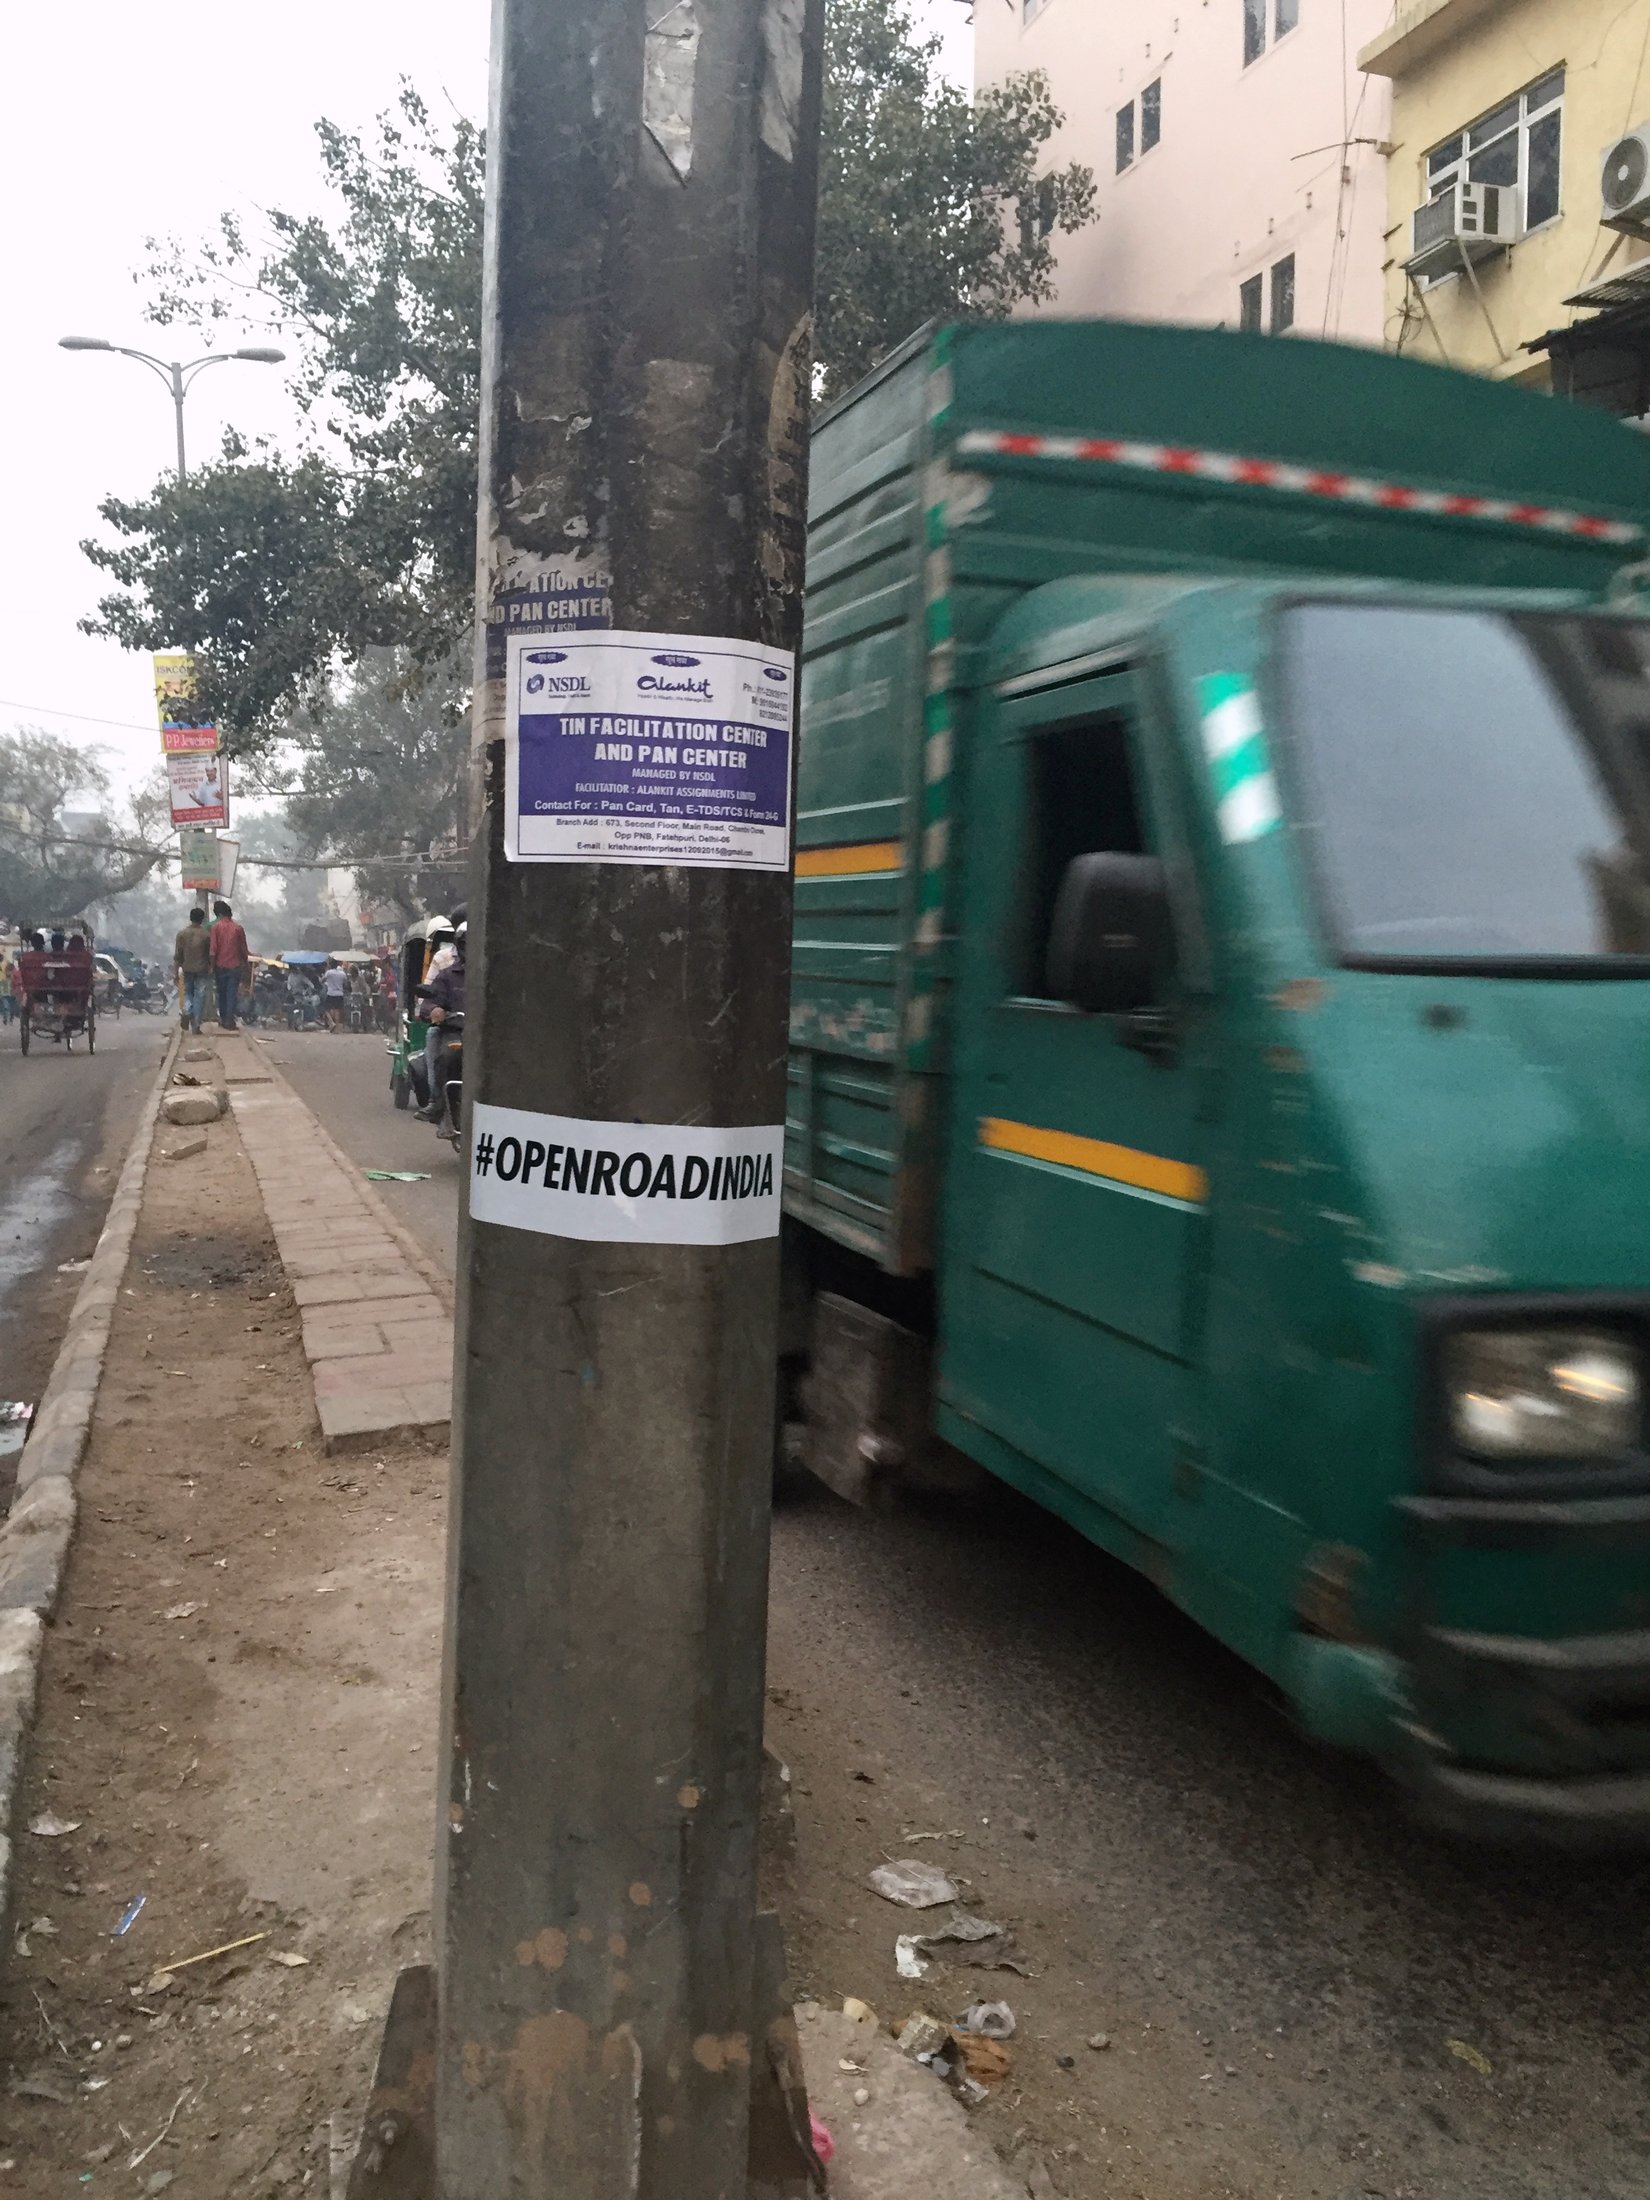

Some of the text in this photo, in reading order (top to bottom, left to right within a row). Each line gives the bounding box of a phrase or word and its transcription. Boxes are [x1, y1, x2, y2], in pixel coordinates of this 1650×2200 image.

[509, 601, 543, 622] PAN
[546, 597, 611, 619] CENTER
[548, 676, 591, 693] NSDL
[637, 675, 713, 699] Alankit
[560, 718, 768, 748] TIN FACILITATION CENTER
[594, 743, 747, 769] AND PAN CENTER
[632, 768, 717, 782] MANAGED BY NSDL
[636, 785, 675, 796] ALANKIT
[676, 787, 736, 800] ASSIGNMENTS
[534, 799, 573, 811] Contact
[574, 800, 592, 811] For
[601, 800, 624, 812] Pan
[625, 801, 657, 815] Card,
[686, 804, 743, 818] E-TDS/TCS
[556, 818, 582, 827] Branch
[582, 818, 599, 827] Add
[624, 820, 656, 830] Second
[657, 821, 681, 831] Floor,
[682, 822, 702, 831] Main
[577, 841, 601, 851] E-mail
[614, 831, 632, 840] Opp
[633, 832, 655, 842] PNB,
[698, 834, 731, 845] Delhi-06
[476, 1132, 775, 1202] #OPENROADINDIA
